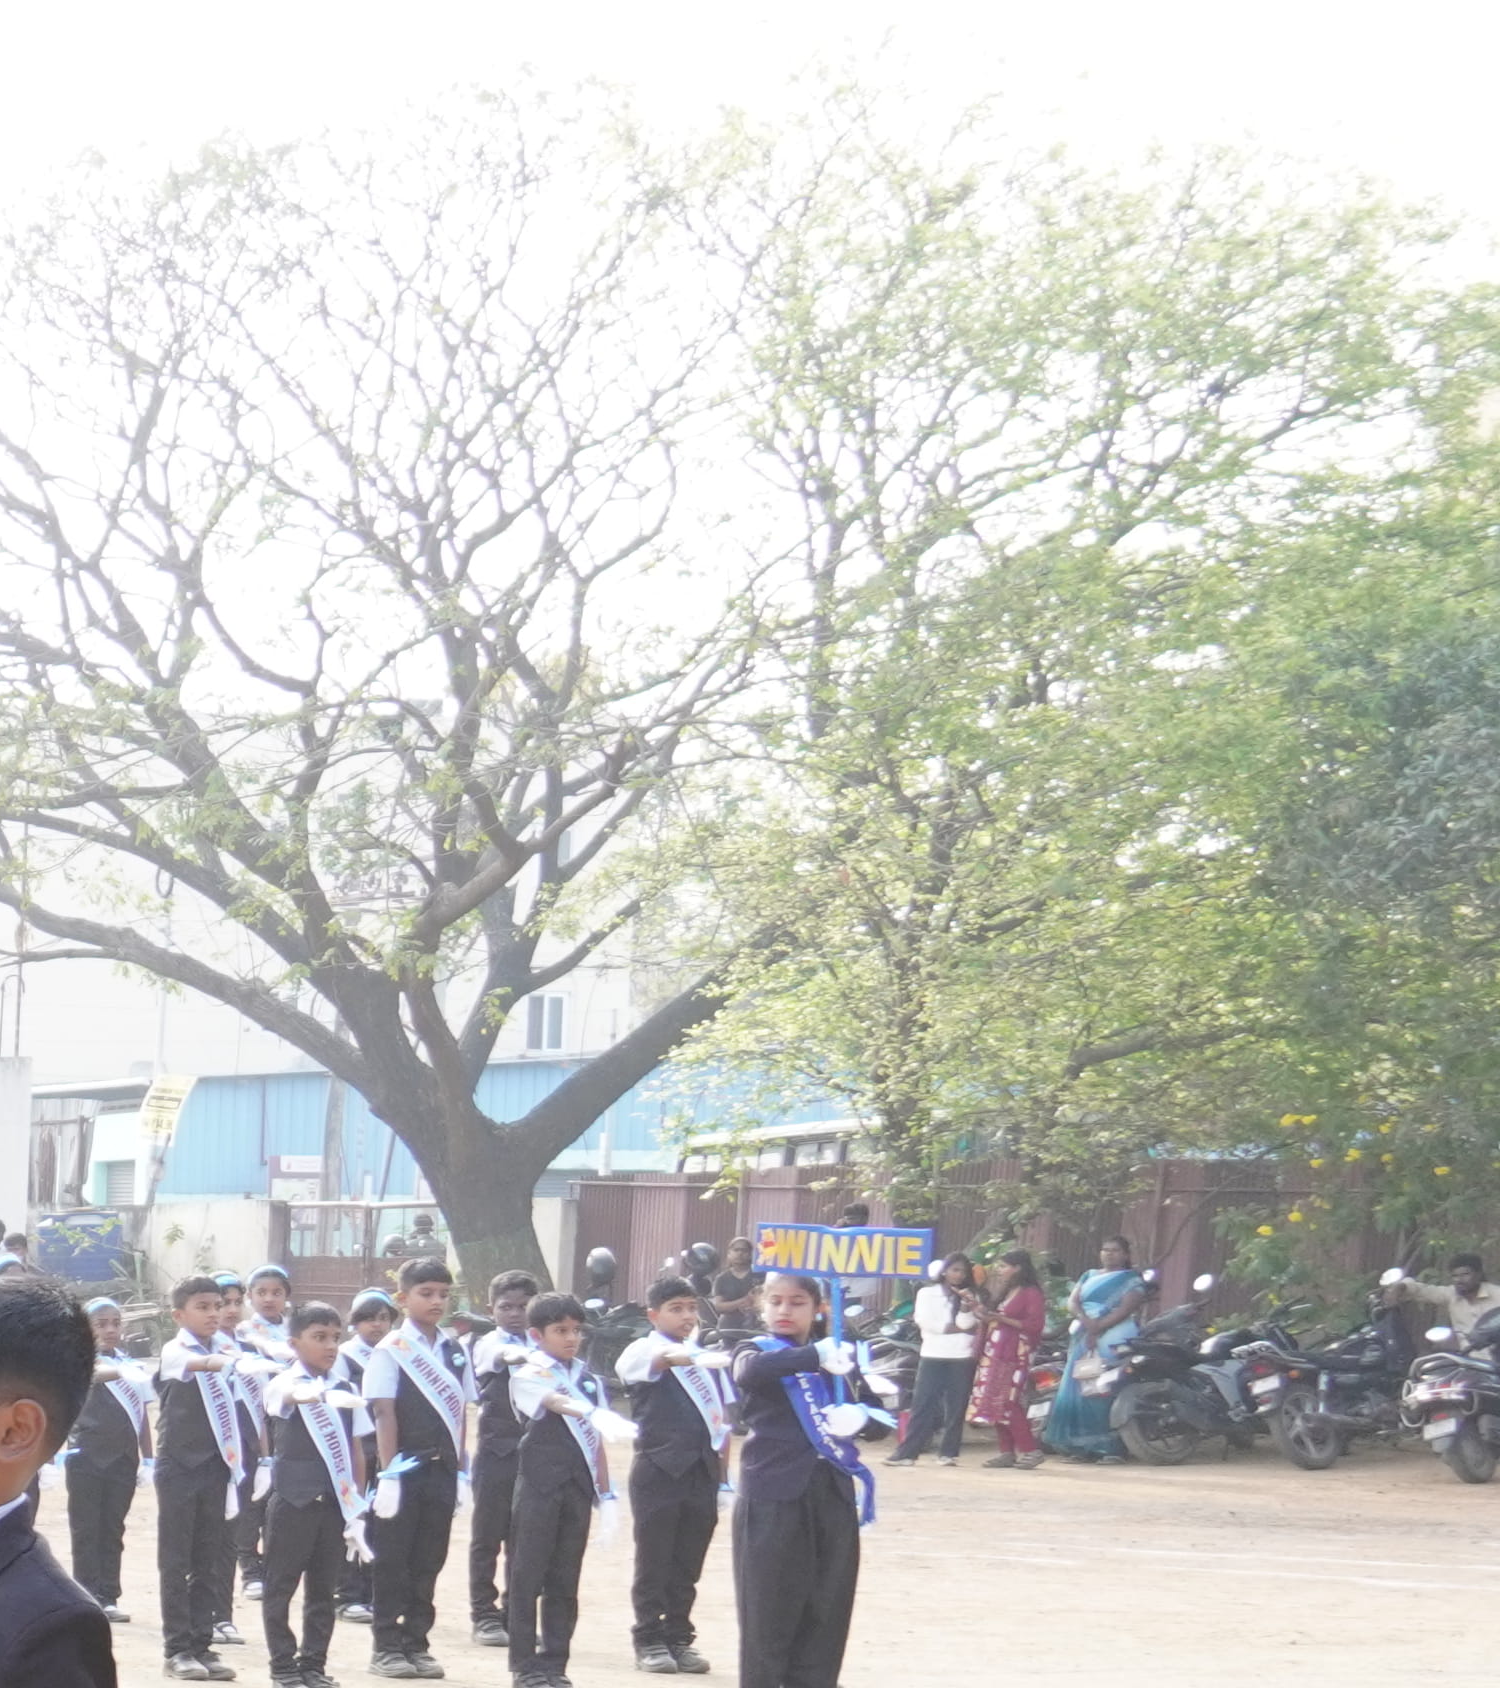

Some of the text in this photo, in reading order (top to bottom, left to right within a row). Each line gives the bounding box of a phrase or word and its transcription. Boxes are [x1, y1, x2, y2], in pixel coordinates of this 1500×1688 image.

[775, 1229, 924, 1275] WINNIE
[411, 1354, 450, 1396] WINNIE
[685, 1367, 714, 1405] HOUSE
[215, 1401, 232, 1443] HOUSE
[323, 1428, 346, 1475] HOUSE
